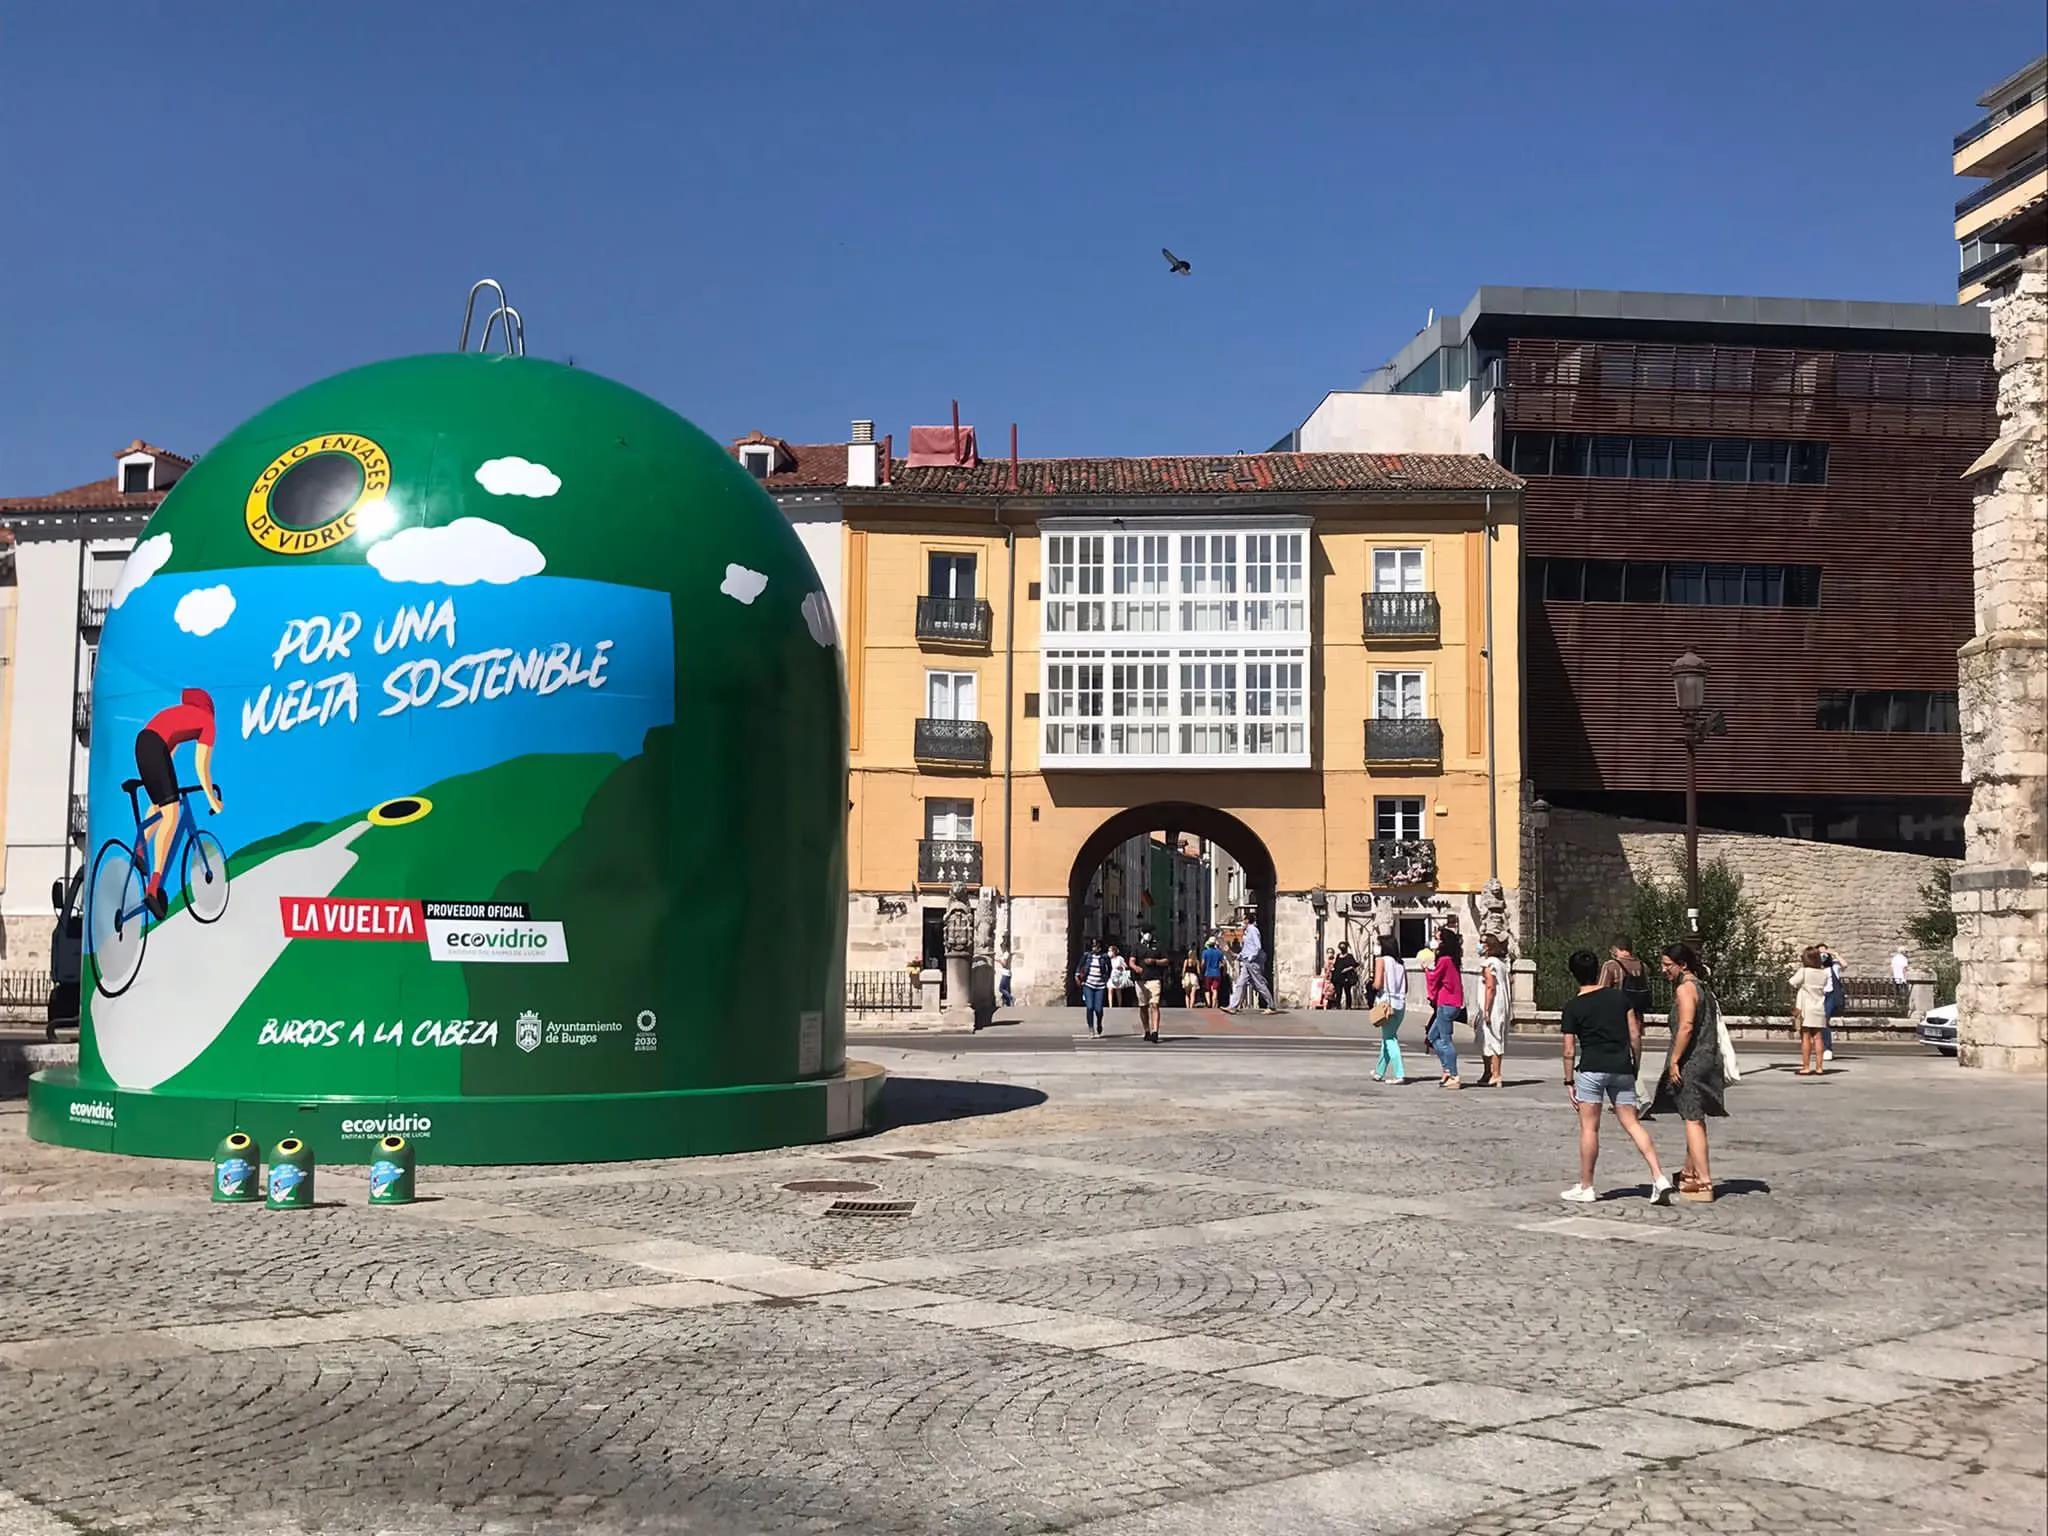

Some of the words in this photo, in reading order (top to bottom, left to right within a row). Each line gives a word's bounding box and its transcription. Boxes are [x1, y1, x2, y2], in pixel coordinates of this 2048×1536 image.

[254, 445, 309, 494] SOLO
[321, 437, 385, 491] ENVASES
[251, 514, 275, 540] DE
[272, 611, 362, 670] POR
[374, 596, 456, 654] UNA
[377, 640, 613, 717] SOSTENIBLE
[291, 903, 319, 931] LA
[323, 904, 414, 934] VUELTA
[427, 903, 485, 917] PROVEEDOR
[488, 905, 524, 918] OFICIAL
[446, 928, 548, 948] ecovidrio
[257, 1018, 344, 1046] BURGOS
[348, 1019, 364, 1046] A
[373, 1018, 403, 1045] LA
[412, 1017, 498, 1047] CABEZA
[545, 1032, 559, 1043] de
[561, 1032, 598, 1046] Burgos
[546, 1021, 622, 1034] Ayuntamiento
[635, 1037, 657, 1045] 2030
[341, 1113, 431, 1133] ecovidrio
